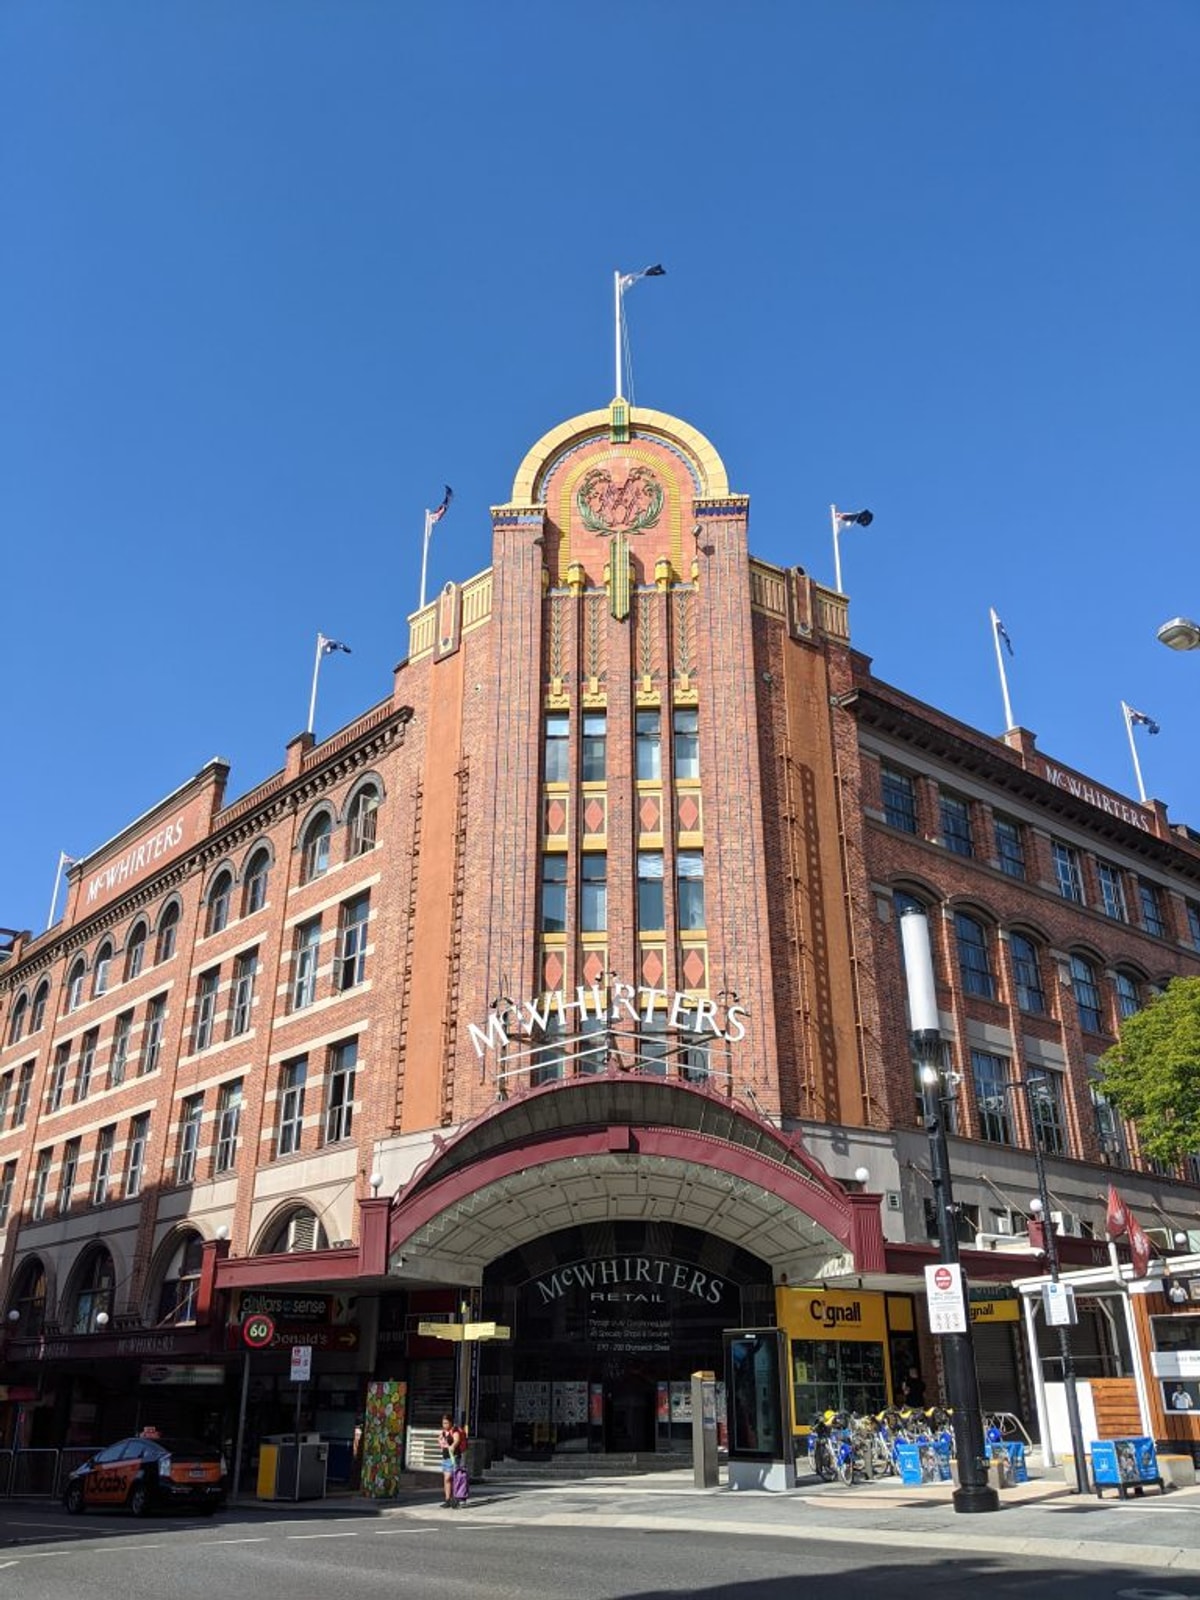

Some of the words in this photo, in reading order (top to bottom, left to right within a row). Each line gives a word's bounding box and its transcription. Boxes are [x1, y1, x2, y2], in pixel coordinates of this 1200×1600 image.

[1045, 765, 1151, 833] McWHIRTERS
[86, 818, 184, 904] McWHIRTERS
[466, 983, 750, 1058] McWHIRTERS
[536, 1257, 724, 1305] McWHIRTERS
[590, 1292, 666, 1303] RETAIL
[293, 1299, 327, 1314] sense
[249, 1324, 268, 1338] 60
